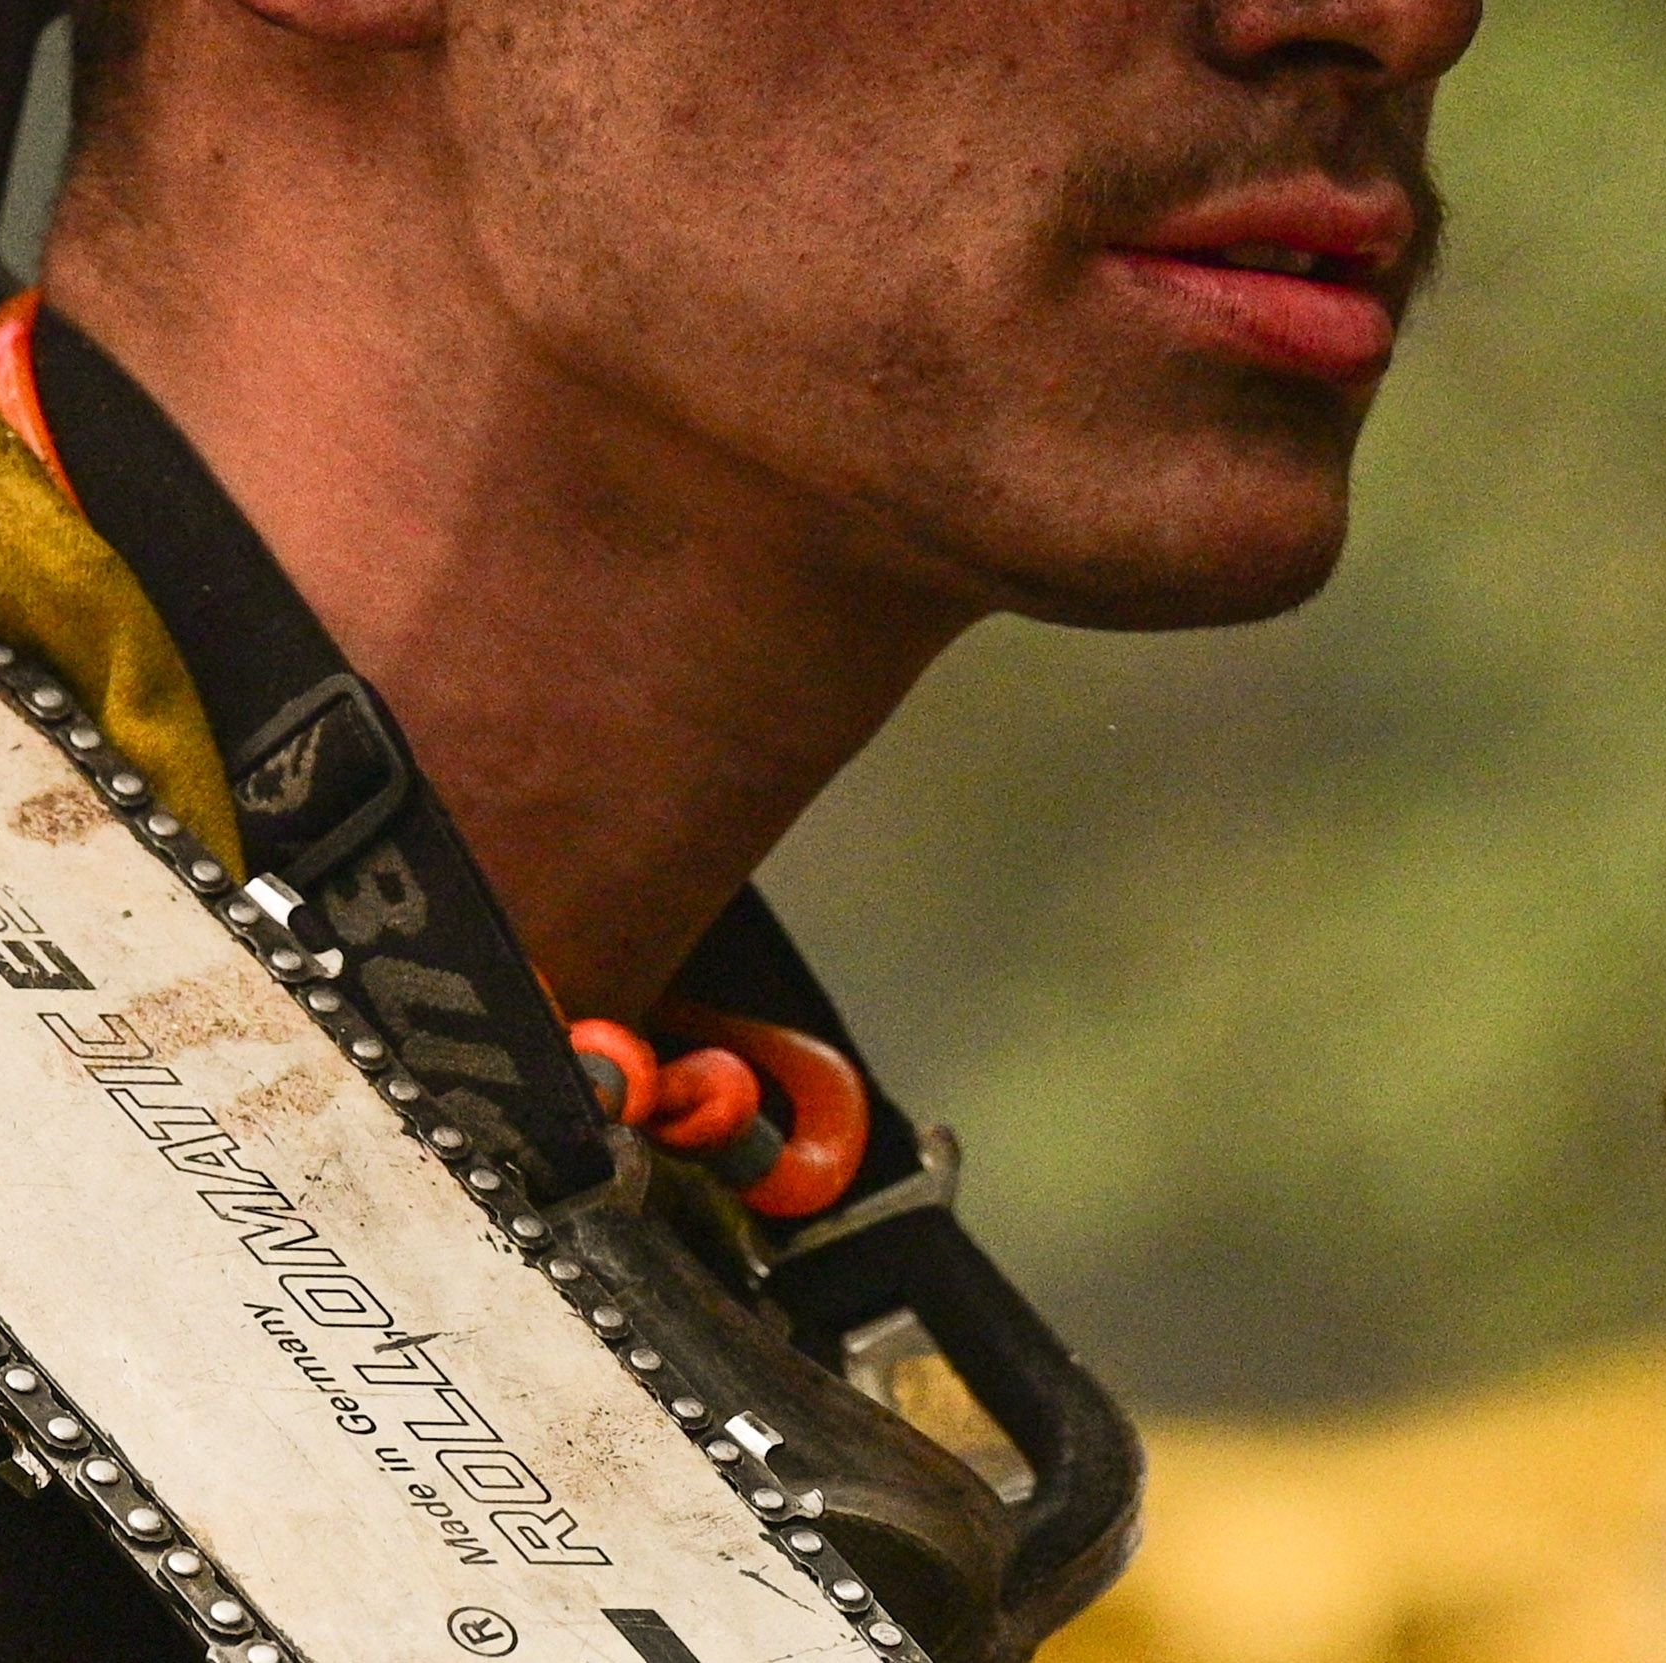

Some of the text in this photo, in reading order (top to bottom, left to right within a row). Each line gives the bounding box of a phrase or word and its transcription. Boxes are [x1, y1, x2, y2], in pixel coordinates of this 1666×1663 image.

[38, 1012, 613, 1567] ROLLOMATIC
[244, 1300, 498, 1566] Made in Germany
